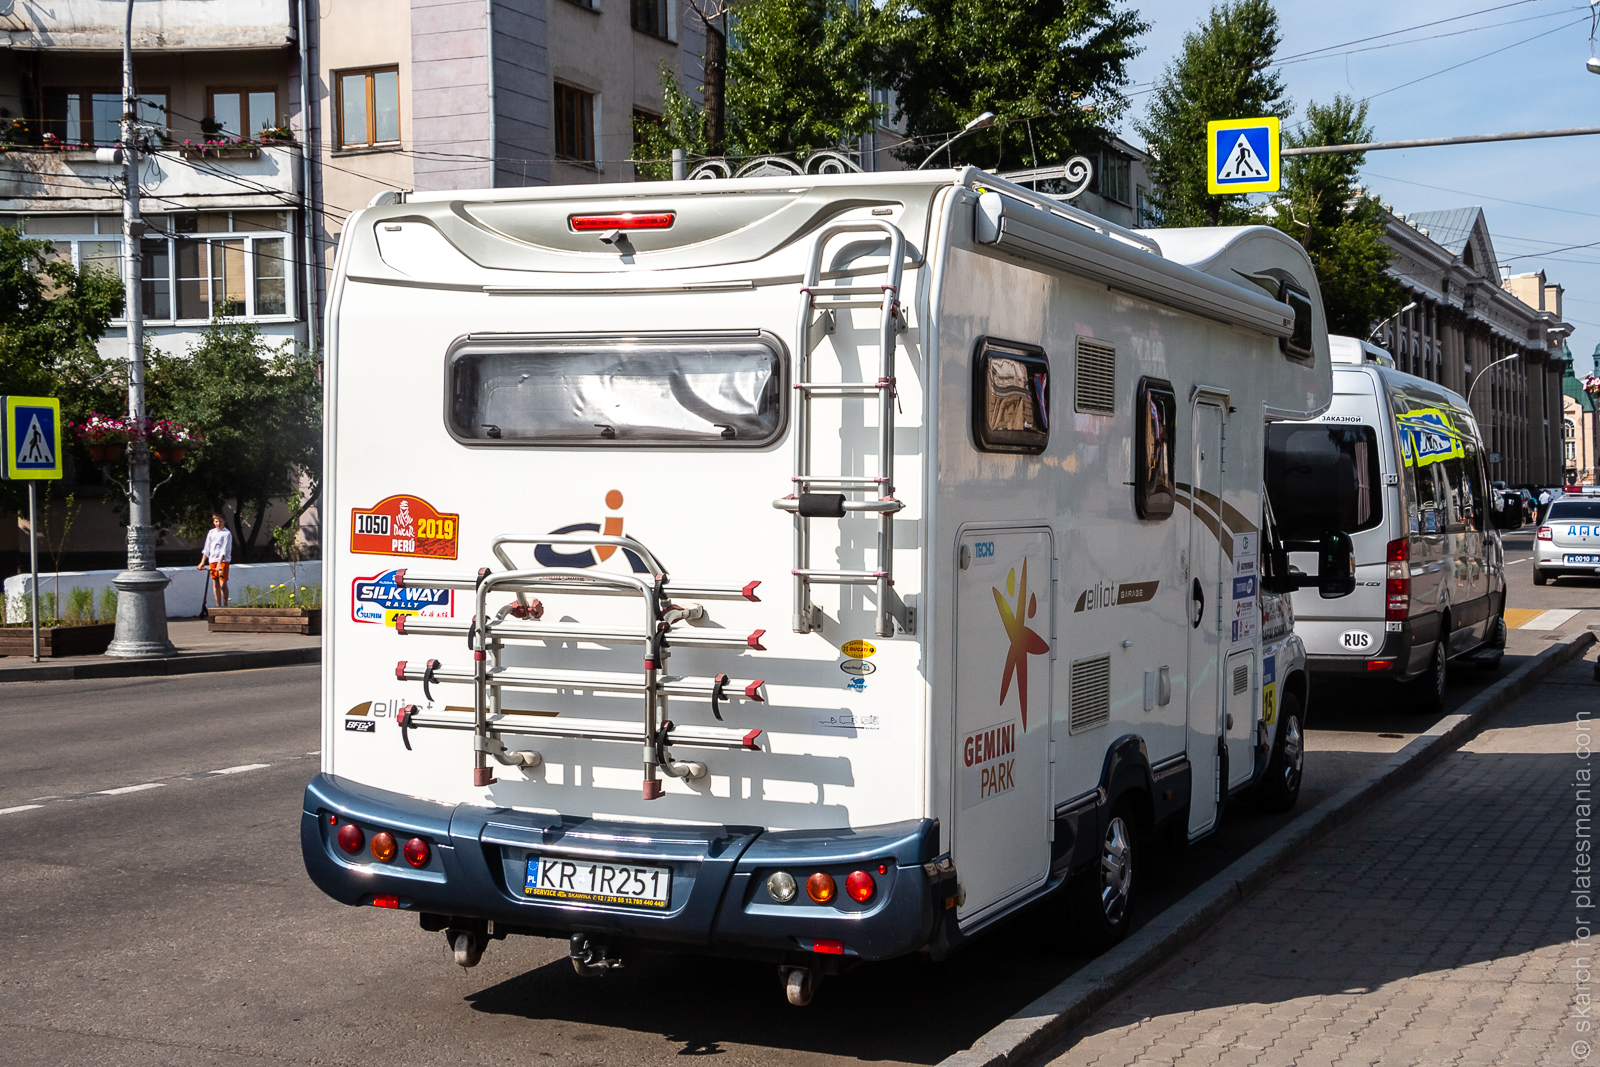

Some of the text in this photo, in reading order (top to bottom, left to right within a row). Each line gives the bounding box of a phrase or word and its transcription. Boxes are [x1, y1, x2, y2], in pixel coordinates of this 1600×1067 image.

[1321, 415, 1361, 423] ЗАКАЗНОЙ
[358, 515, 388, 534] 1050
[393, 524, 415, 537] DAKAR
[417, 518, 454, 539] 2019
[391, 538, 415, 552] PERÚ
[975, 541, 995, 558] TECHO
[360, 585, 445, 602] SILK WAY
[1086, 580, 1143, 611] elliot GARAGE
[1344, 634, 1368, 646] RUS
[964, 723, 1015, 767] GEMINI
[981, 758, 1015, 799] PARK
[527, 875, 536, 883] PL
[541, 860, 660, 898] KR 1R251
[533, 888, 556, 897] SERVICE
